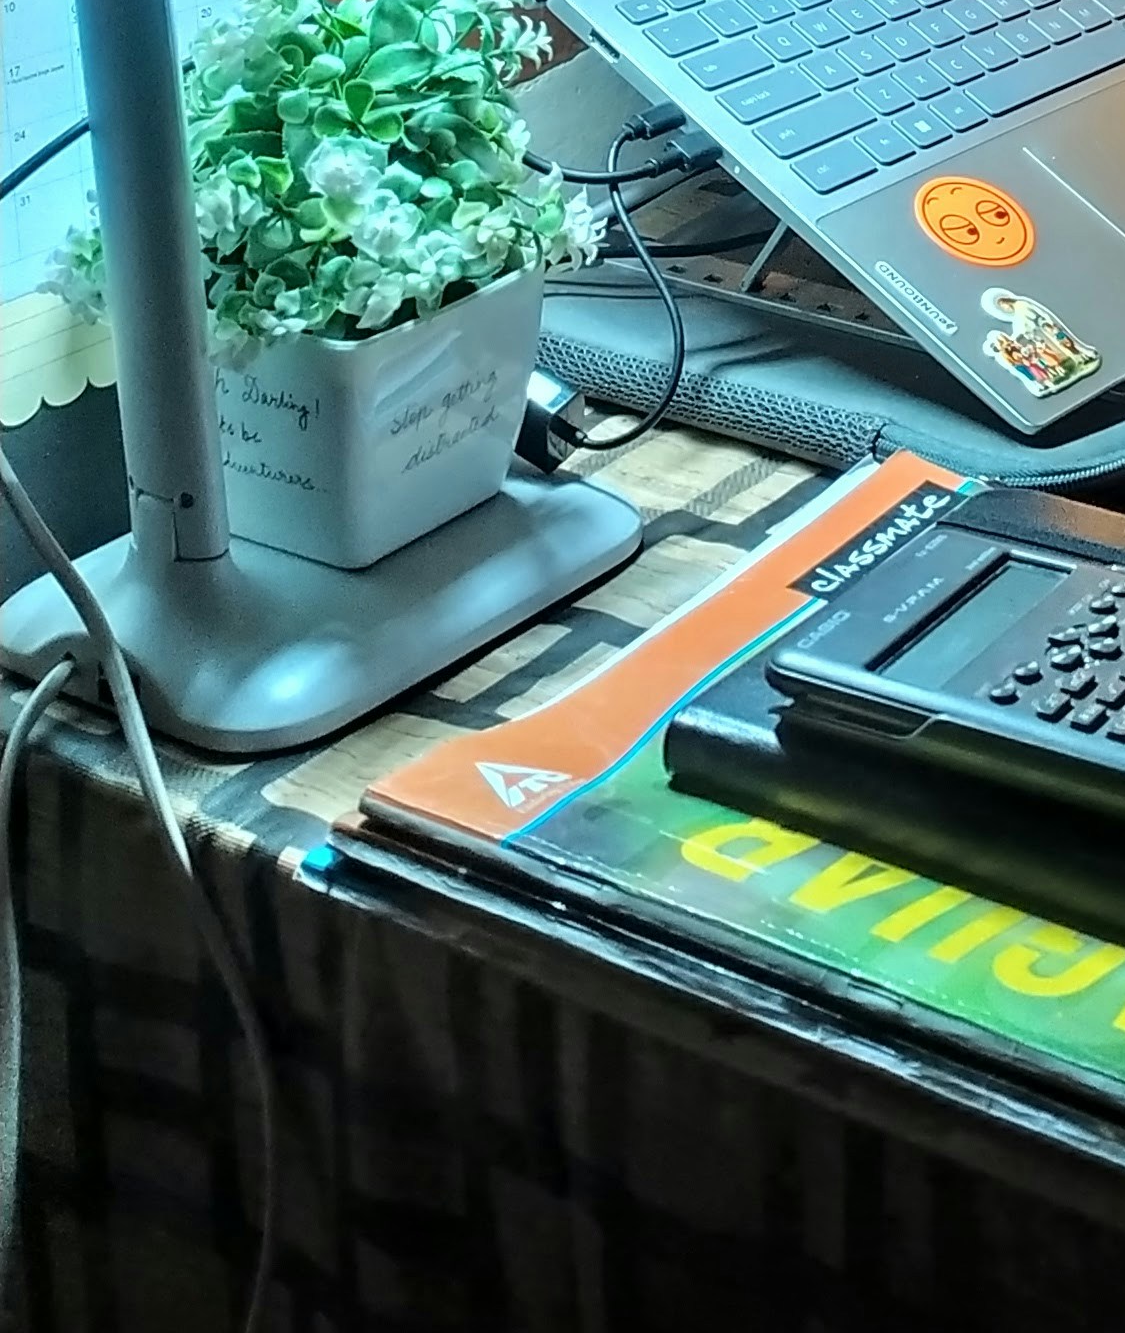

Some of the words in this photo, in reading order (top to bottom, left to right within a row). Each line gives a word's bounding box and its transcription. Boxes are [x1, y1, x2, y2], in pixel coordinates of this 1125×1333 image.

[4, 2, 16, 13] 10
[201, 7, 213, 18] 20
[9, 65, 21, 77] 17
[20, 195, 31, 206] 31
[241, 373, 320, 431] Darling!
[438, 370, 497, 429] getting
[401, 404, 500, 475] distracted
[796, 609, 851, 650] CASIO
